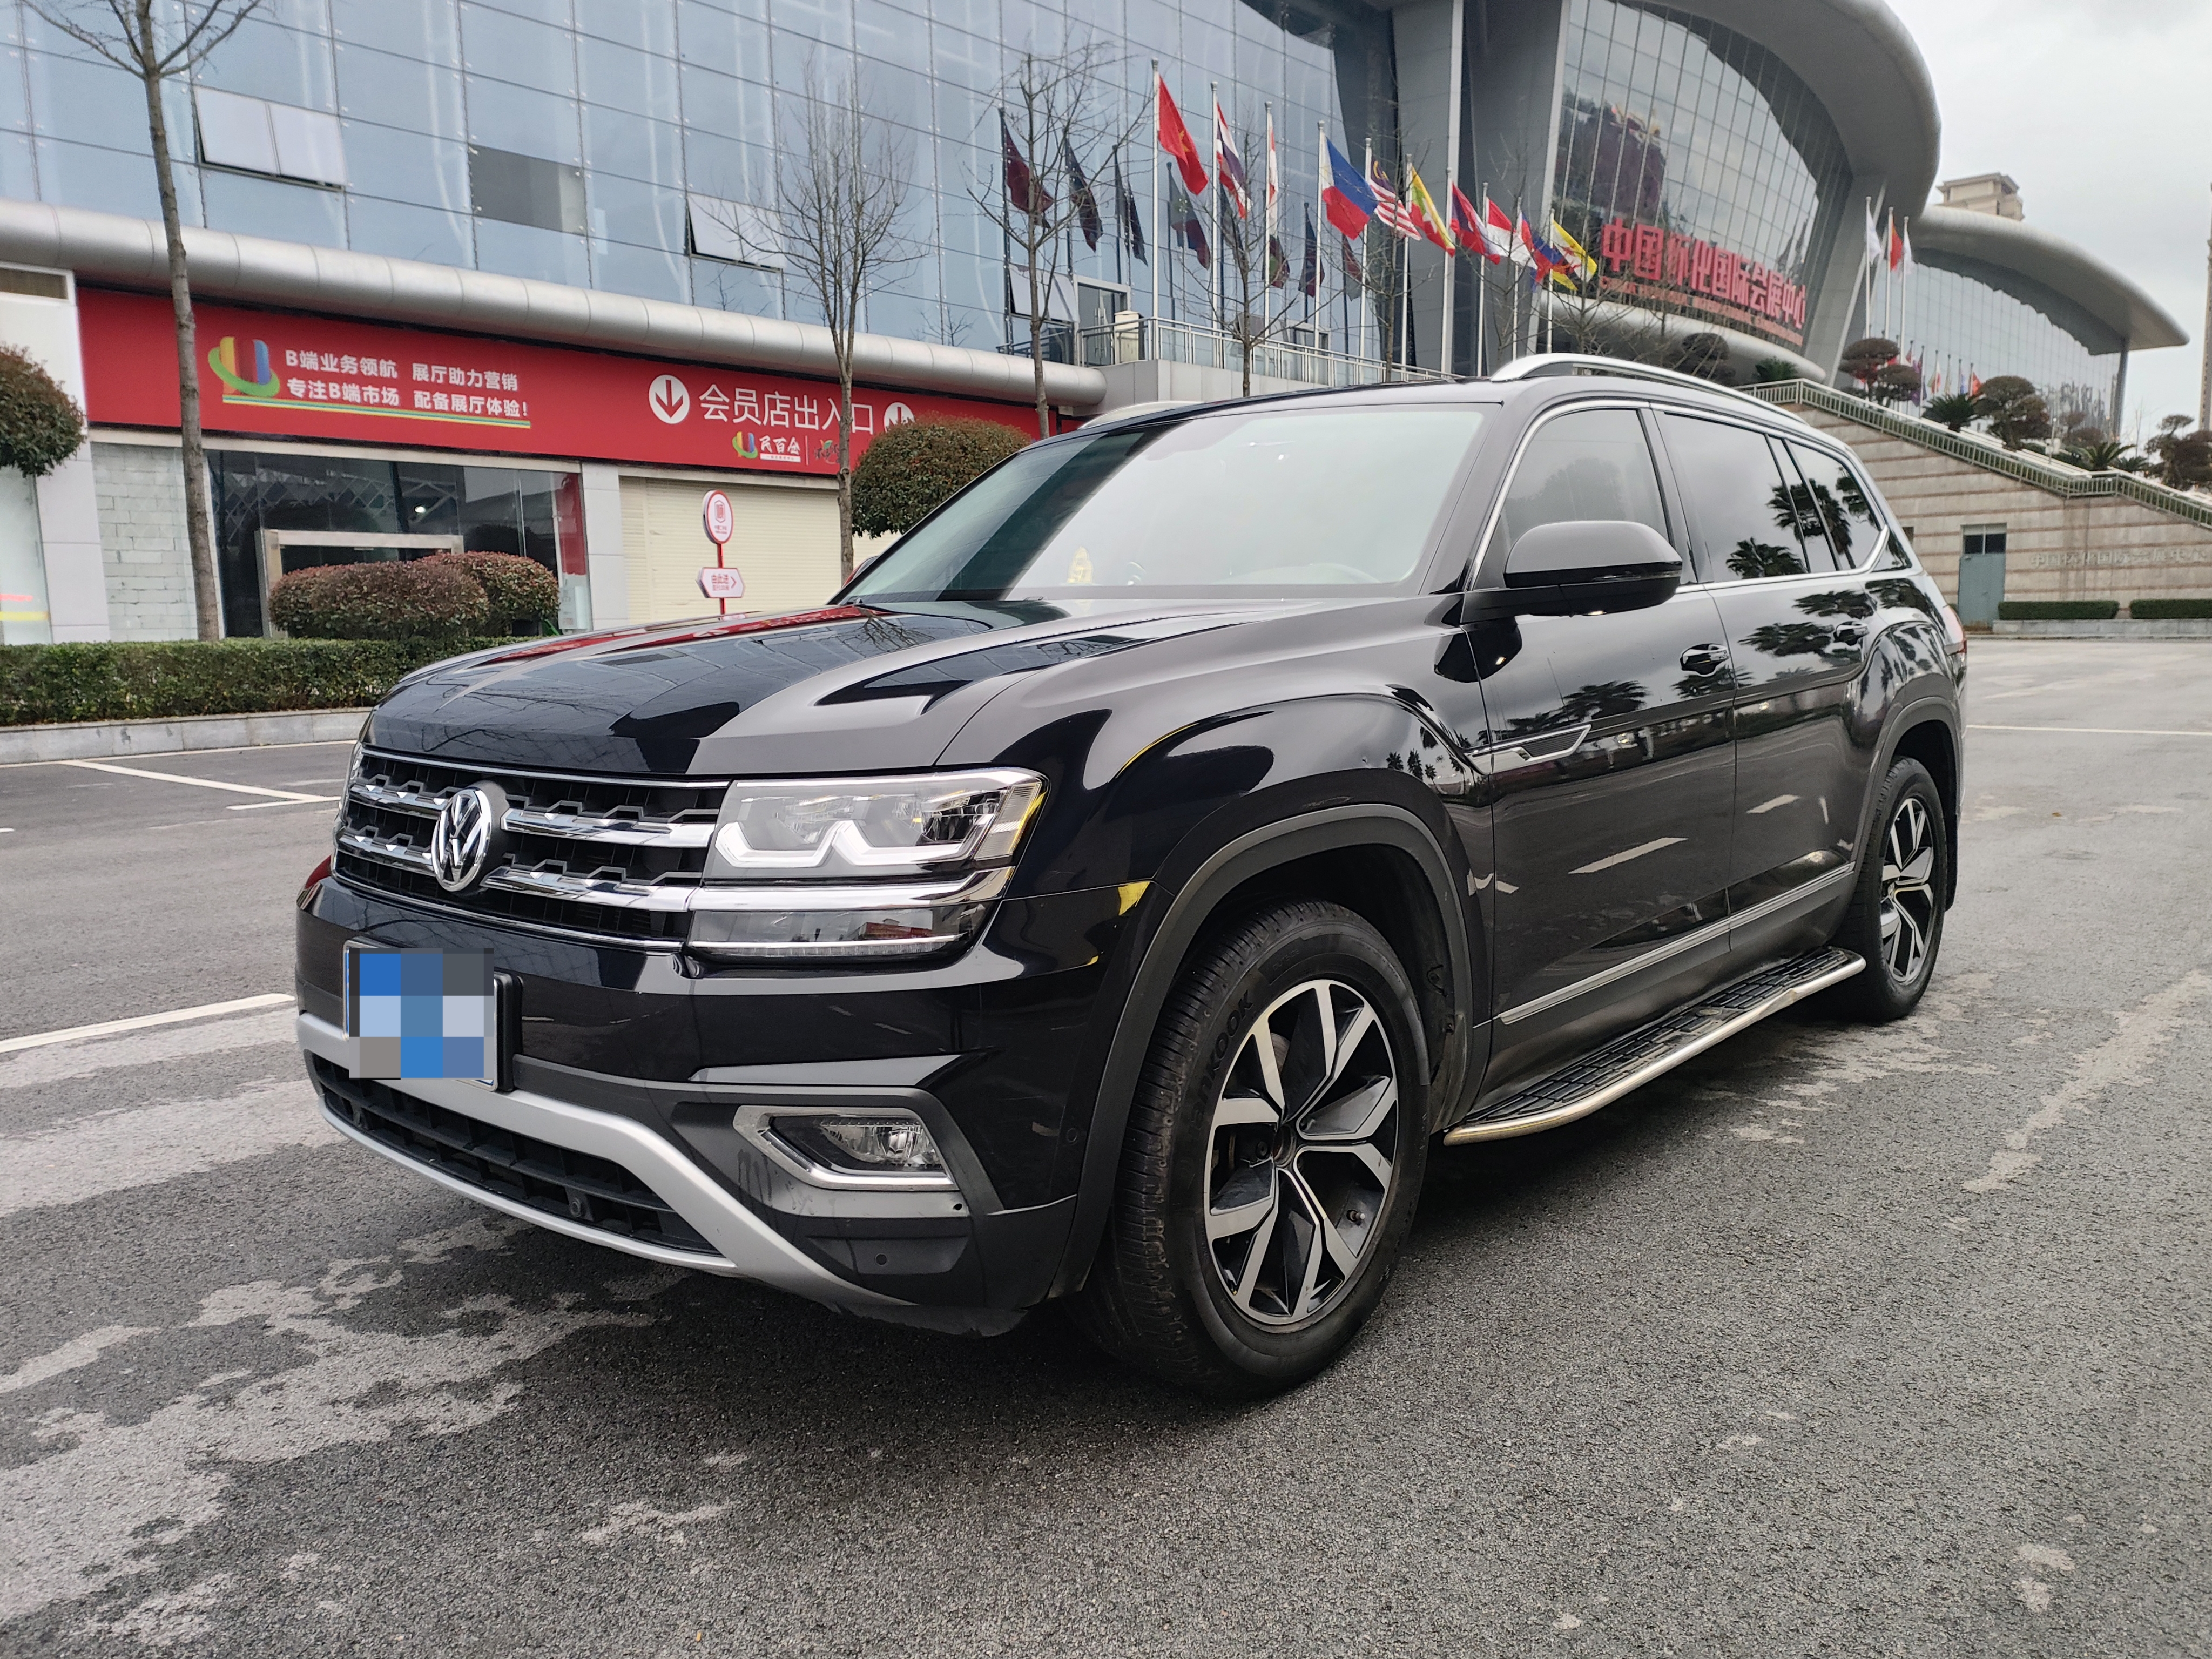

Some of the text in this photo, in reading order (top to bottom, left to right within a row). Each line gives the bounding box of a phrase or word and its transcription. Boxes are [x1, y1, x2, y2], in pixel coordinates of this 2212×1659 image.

[1601, 218, 1806, 329] 中国怀化国际会展中心
[286, 349, 518, 392] B端业务领航 展厅助力营销
[286, 377, 400, 407] 专注B端市场
[699, 383, 874, 435] 会员店出入口
